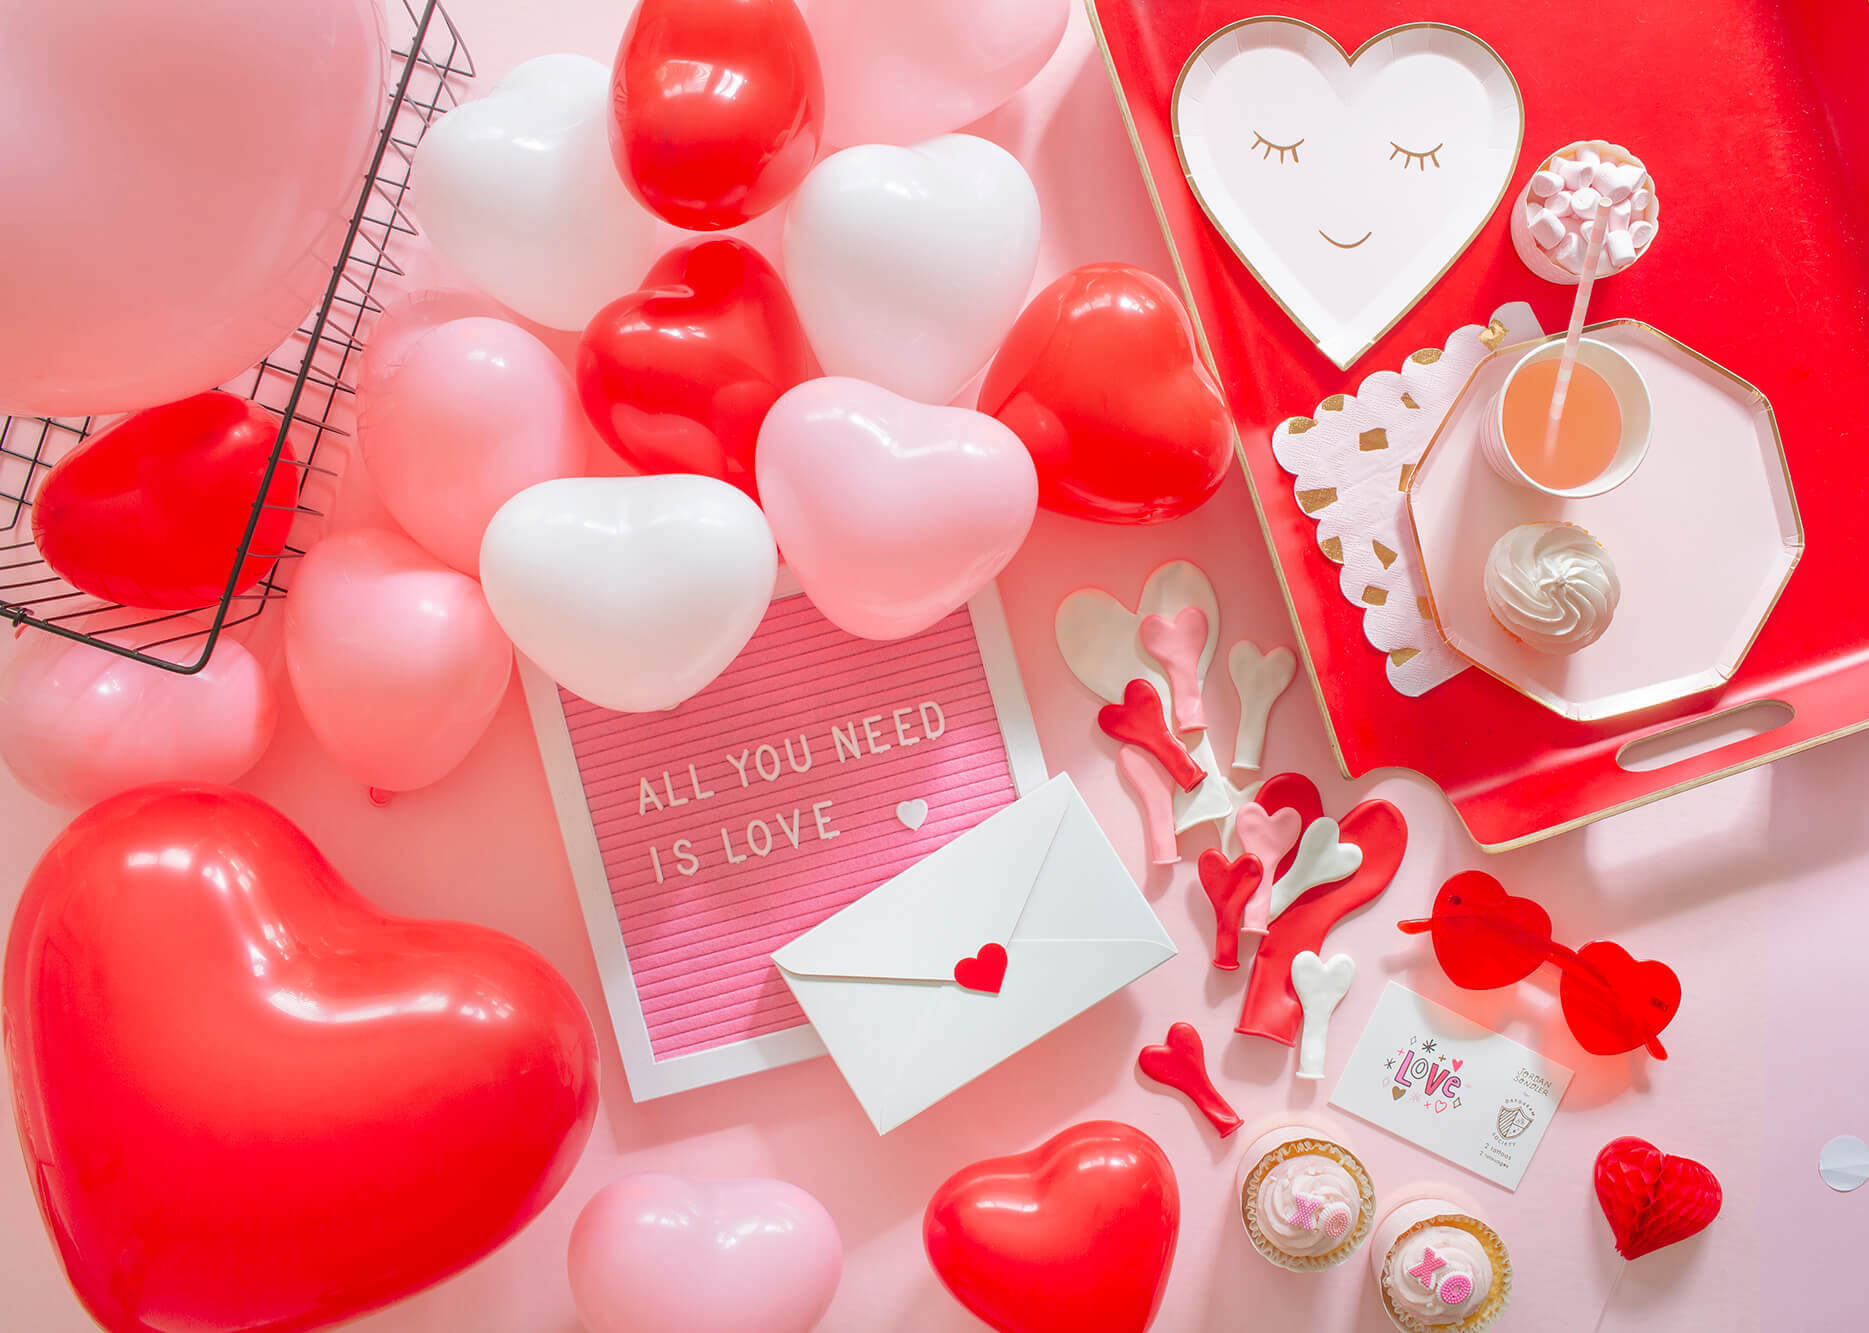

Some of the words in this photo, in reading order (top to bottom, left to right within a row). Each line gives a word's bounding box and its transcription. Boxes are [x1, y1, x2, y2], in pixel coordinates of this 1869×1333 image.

[639, 763, 715, 816] ALL
[726, 734, 813, 788] YOU
[831, 701, 946, 763] NEED
[650, 839, 700, 884] IS
[721, 800, 841, 864] LOVE
[1517, 1067, 1552, 1088] JORDAN
